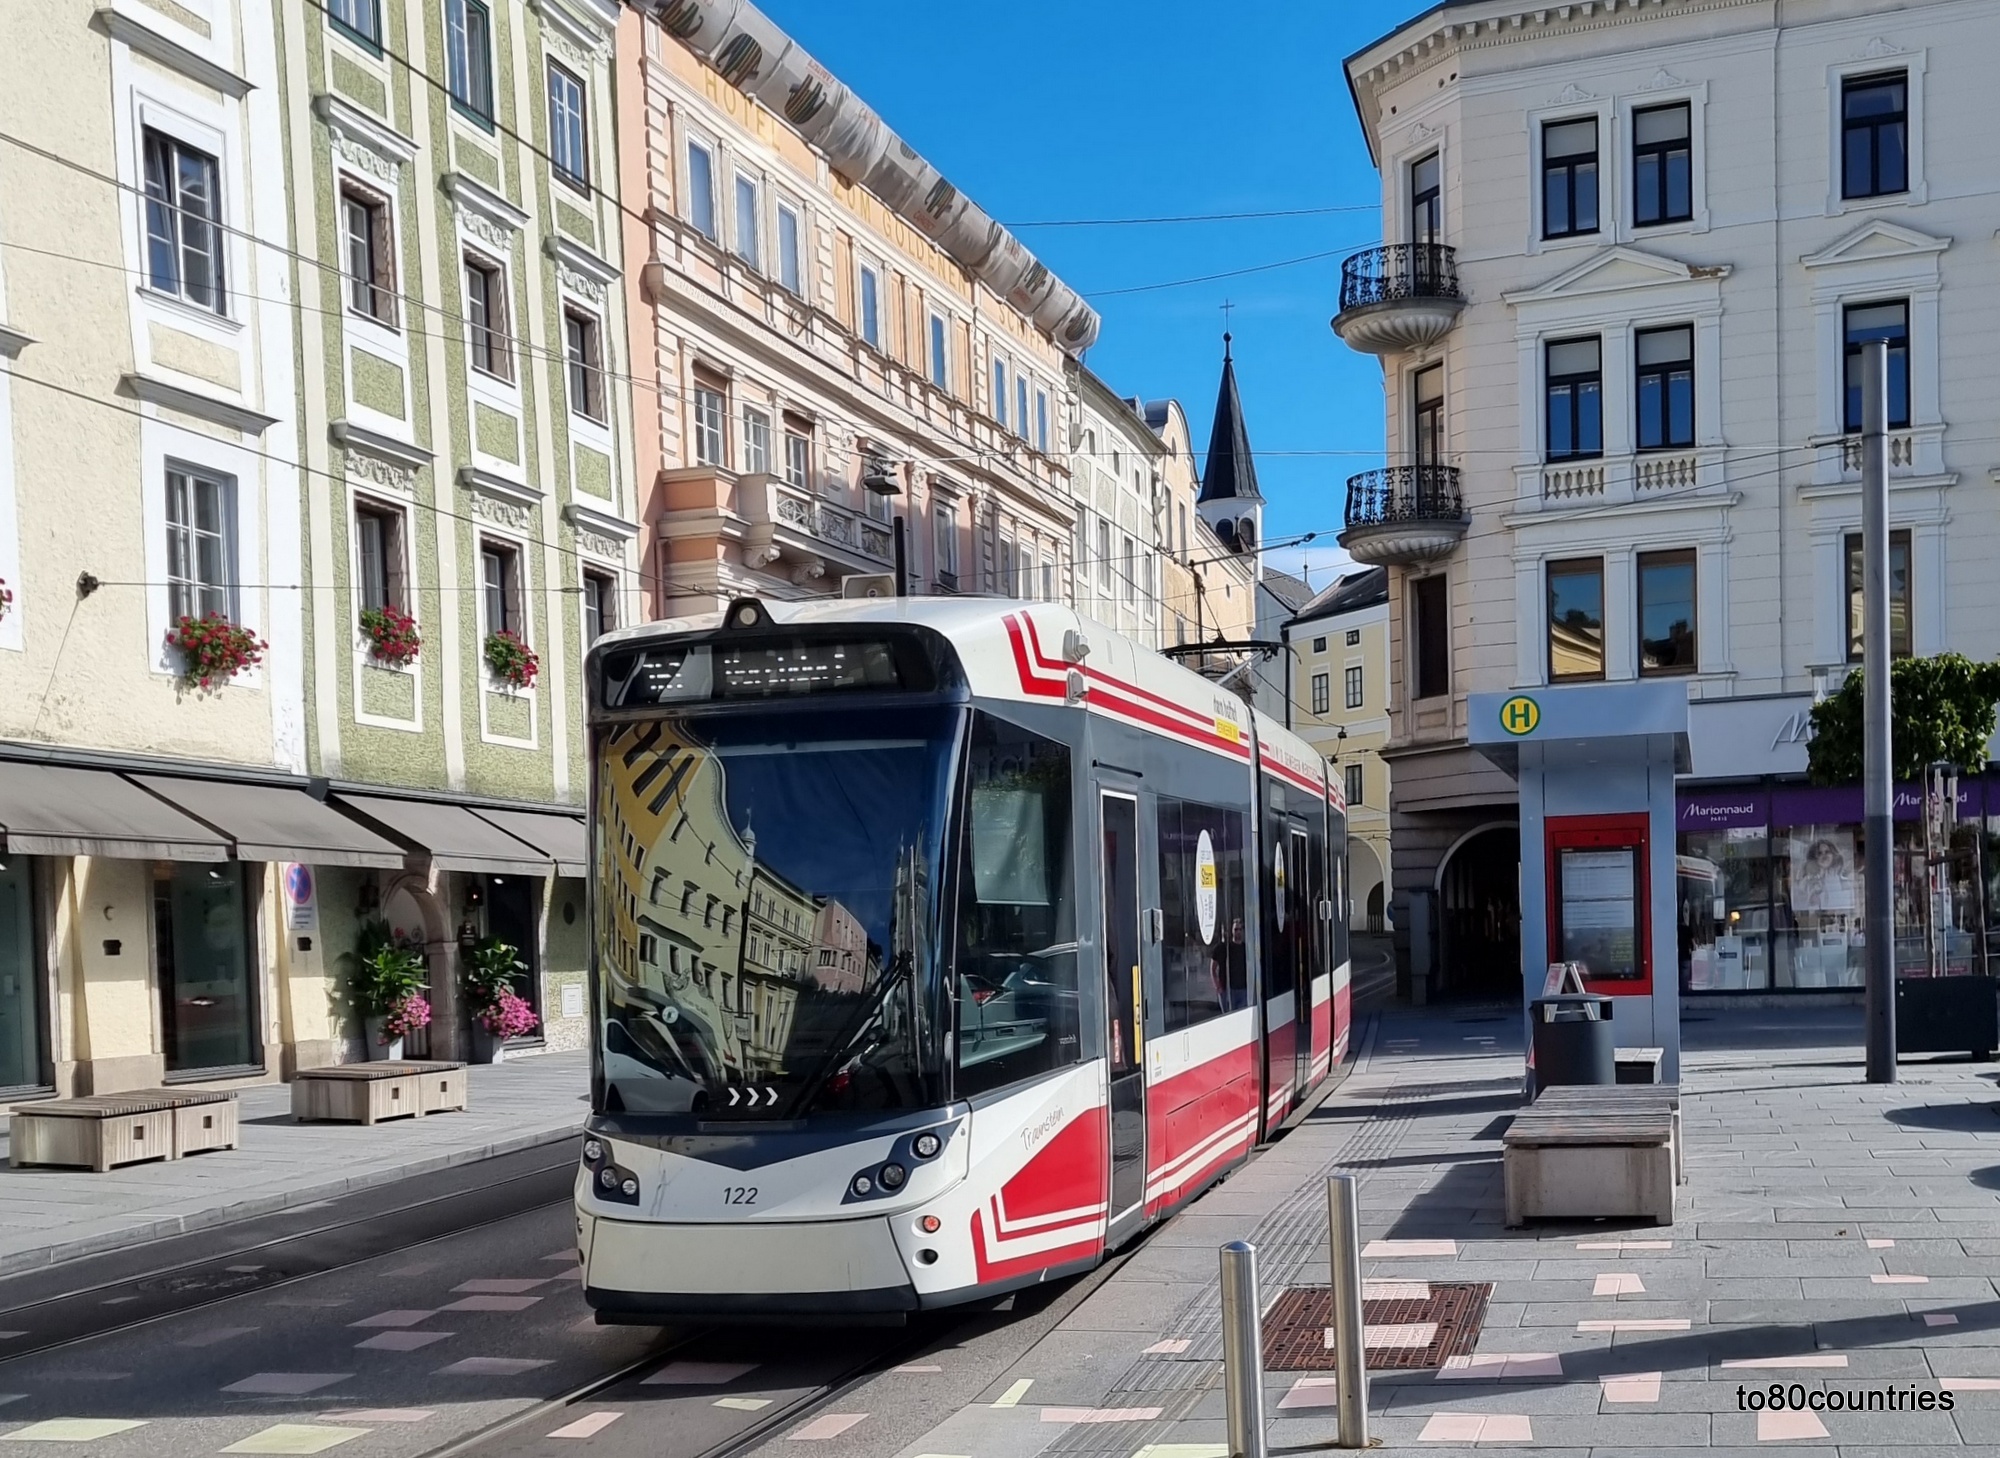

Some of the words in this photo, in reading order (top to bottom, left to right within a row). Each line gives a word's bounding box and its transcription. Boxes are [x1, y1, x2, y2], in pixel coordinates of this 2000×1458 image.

[1510, 703, 1530, 728] H
[1682, 803, 1754, 820] Marionnaud
[1020, 1105, 1065, 1151] Traunstein
[724, 1187, 758, 1205] 122
